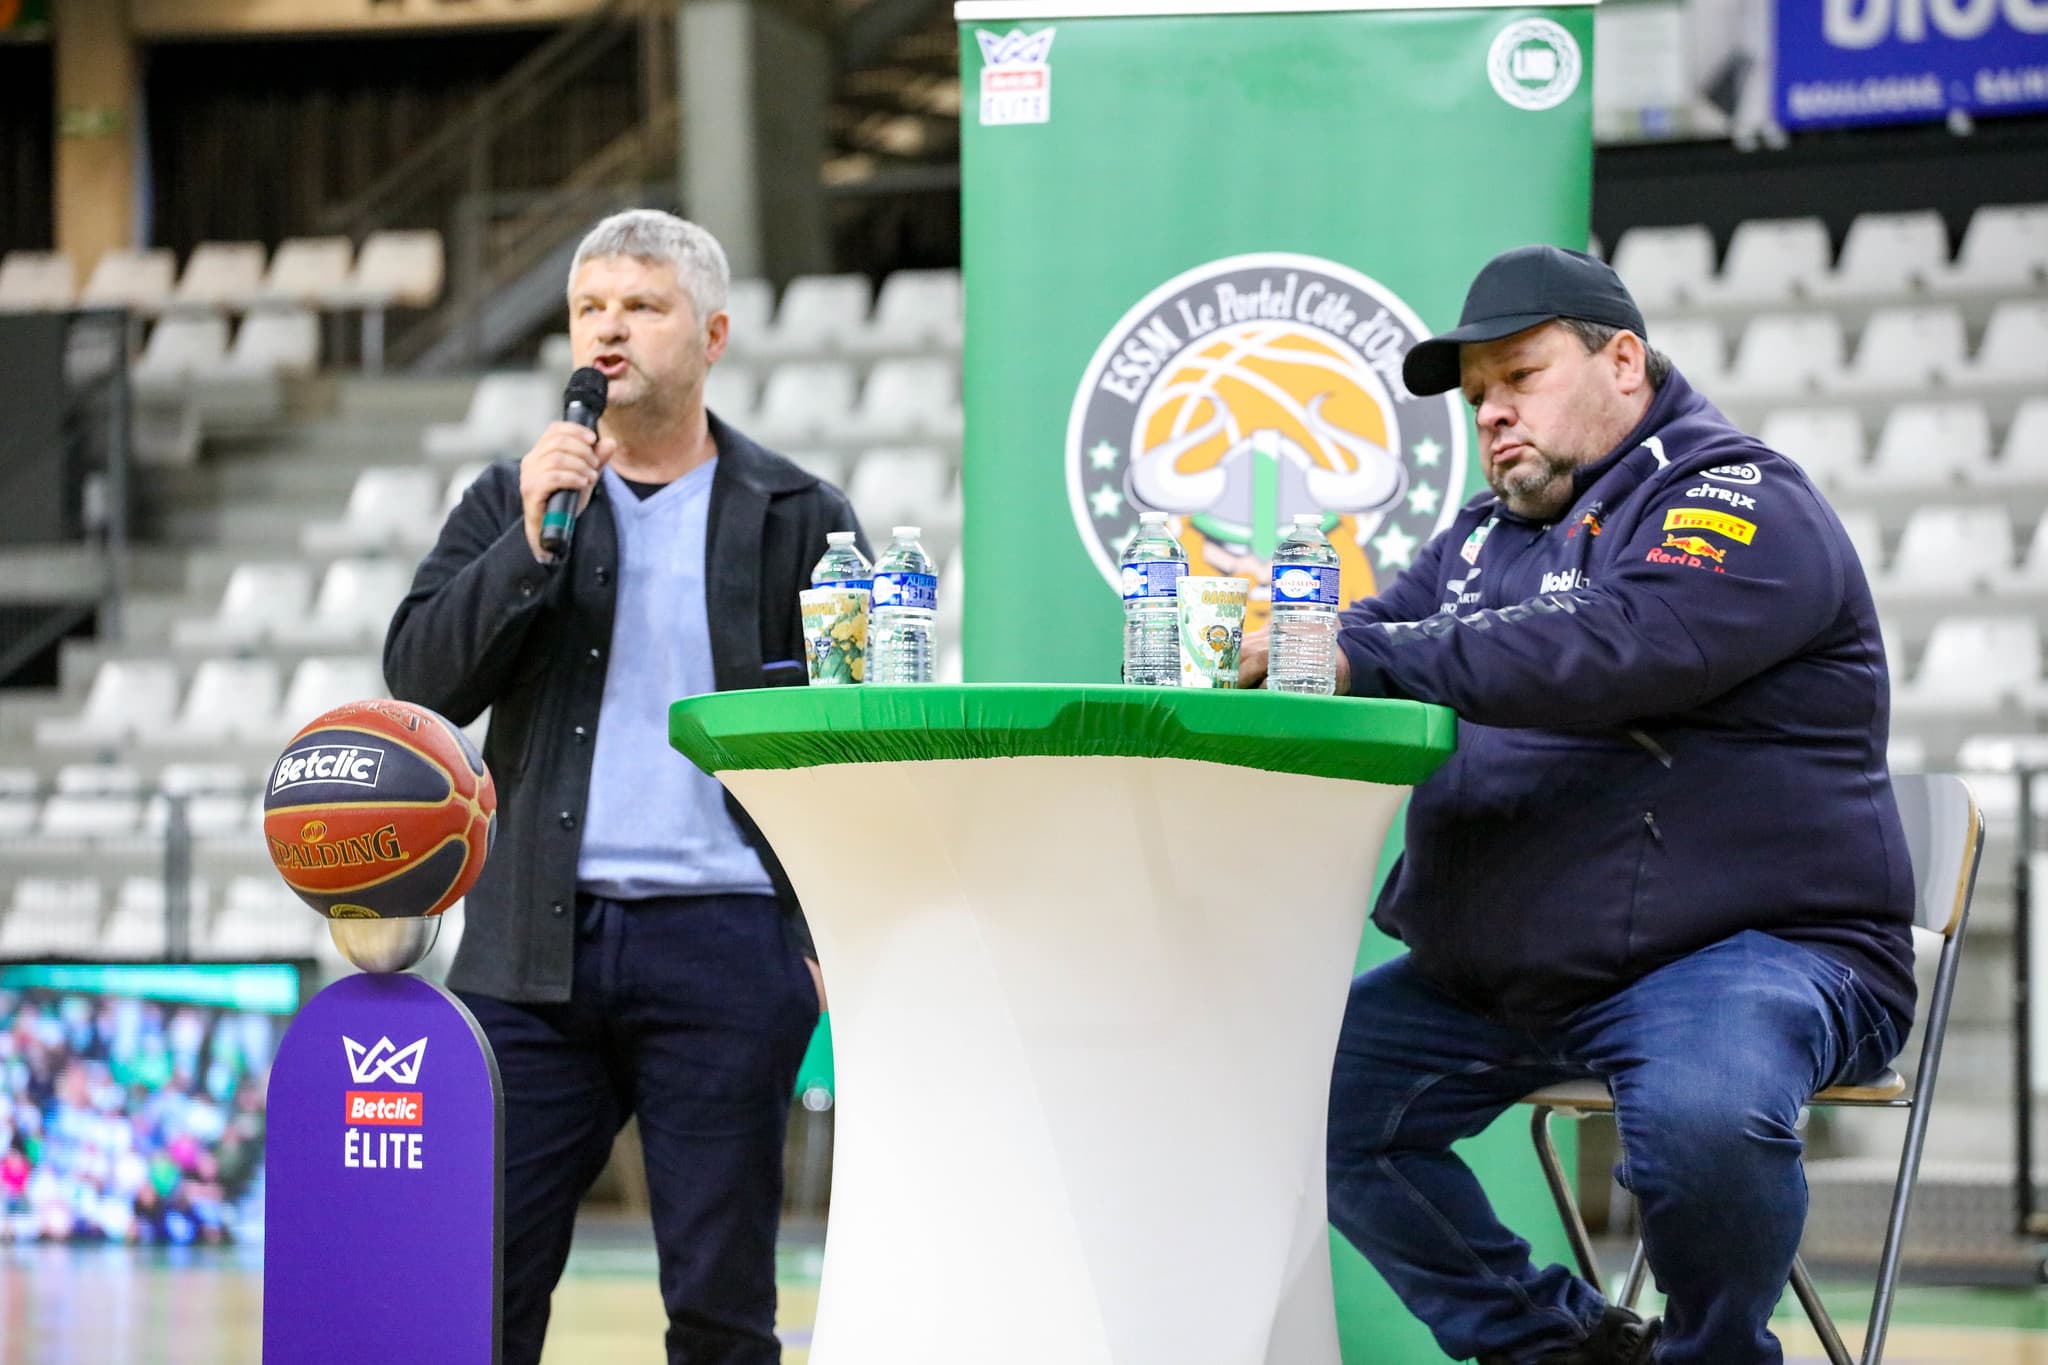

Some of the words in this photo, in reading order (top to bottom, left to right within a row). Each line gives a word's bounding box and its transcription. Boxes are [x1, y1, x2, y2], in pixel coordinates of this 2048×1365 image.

[1100, 314, 1184, 404] ESSM
[1176, 298, 1218, 338] Le
[1213, 271, 1298, 325] Portel
[1645, 547, 1688, 565] Red
[275, 749, 375, 784] Betclic
[351, 1096, 418, 1121] Betclic
[344, 1128, 424, 1169] ÉLITE
